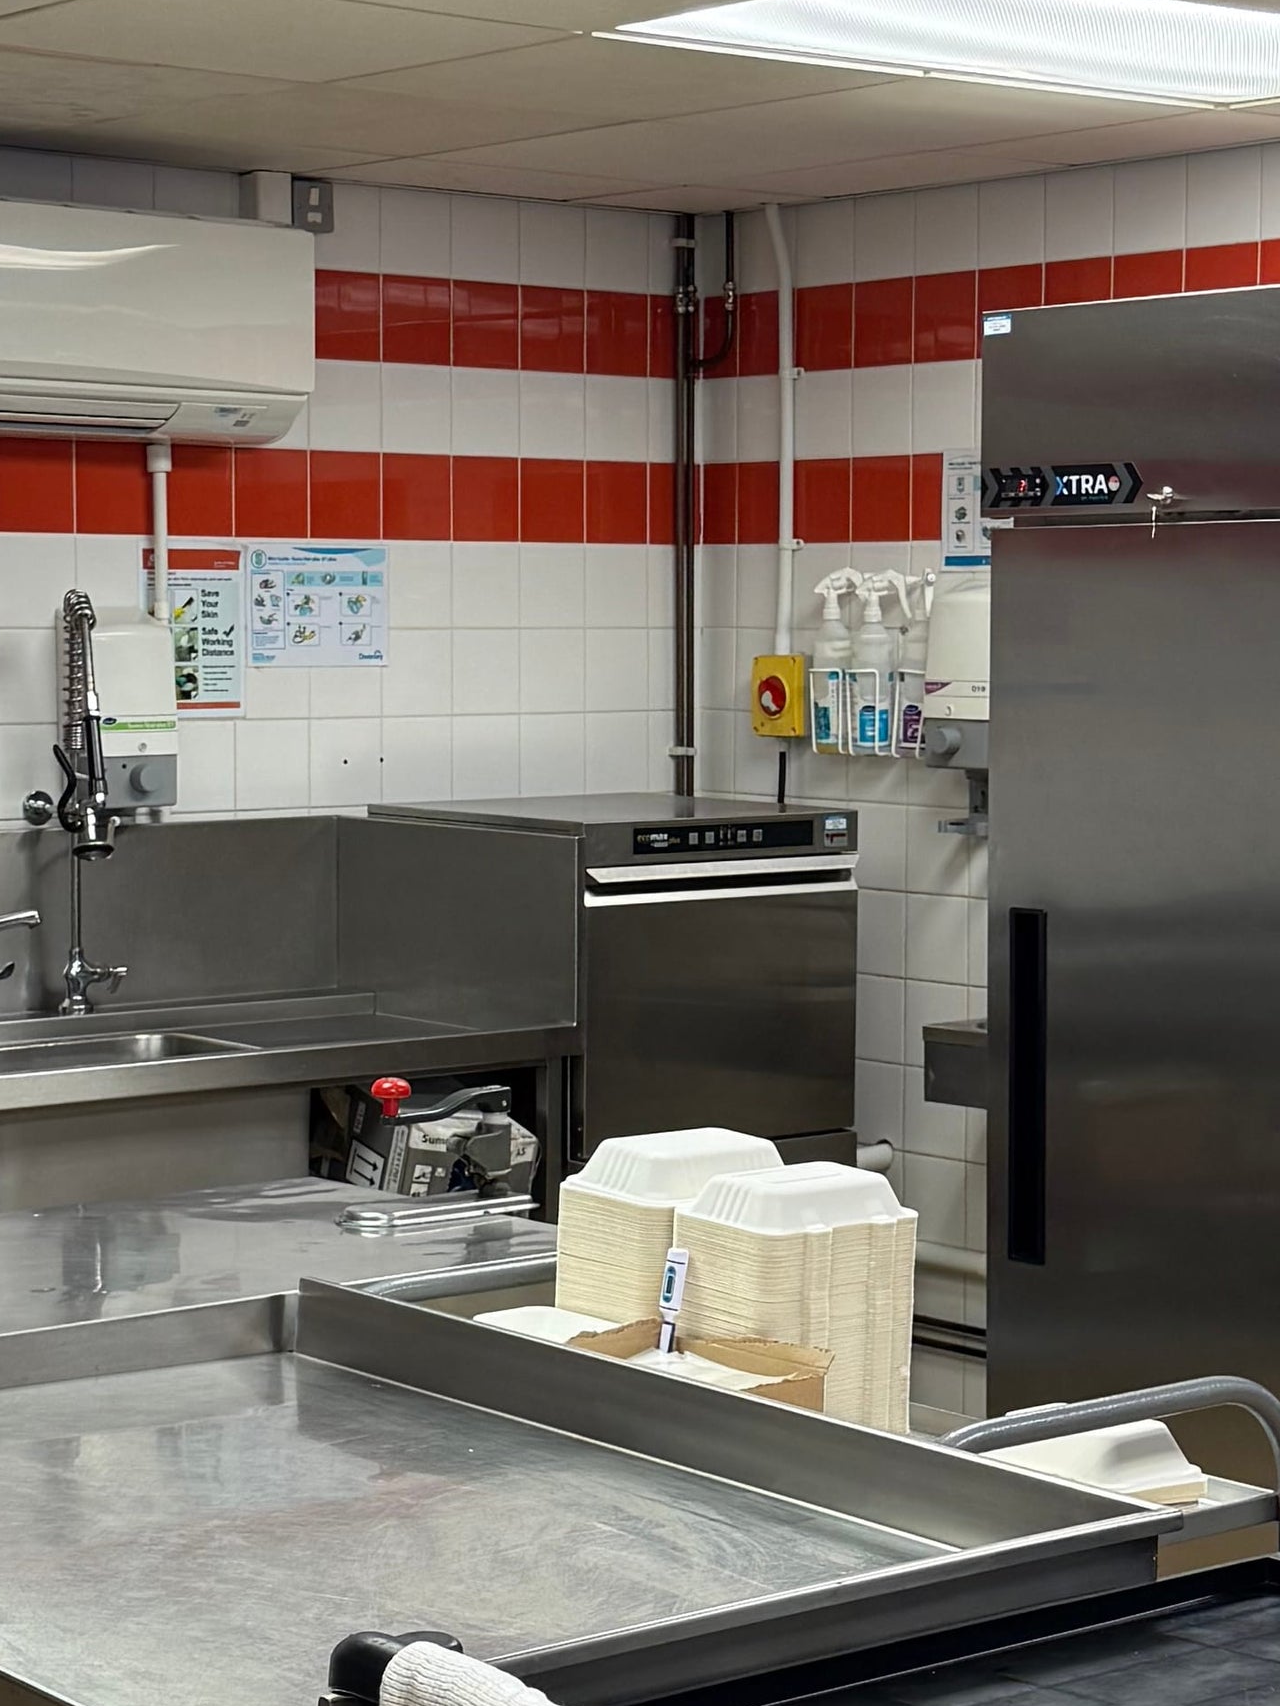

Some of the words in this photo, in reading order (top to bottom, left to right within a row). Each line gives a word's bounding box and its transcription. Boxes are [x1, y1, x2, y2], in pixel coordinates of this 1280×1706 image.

[1056, 473, 1109, 496] XTRA
[201, 589, 220, 598] Save
[201, 600, 219, 608] Your
[201, 610, 219, 619] Skin
[201, 627, 219, 635] Safe
[201, 638, 234, 647] Working
[201, 649, 235, 657] Distance
